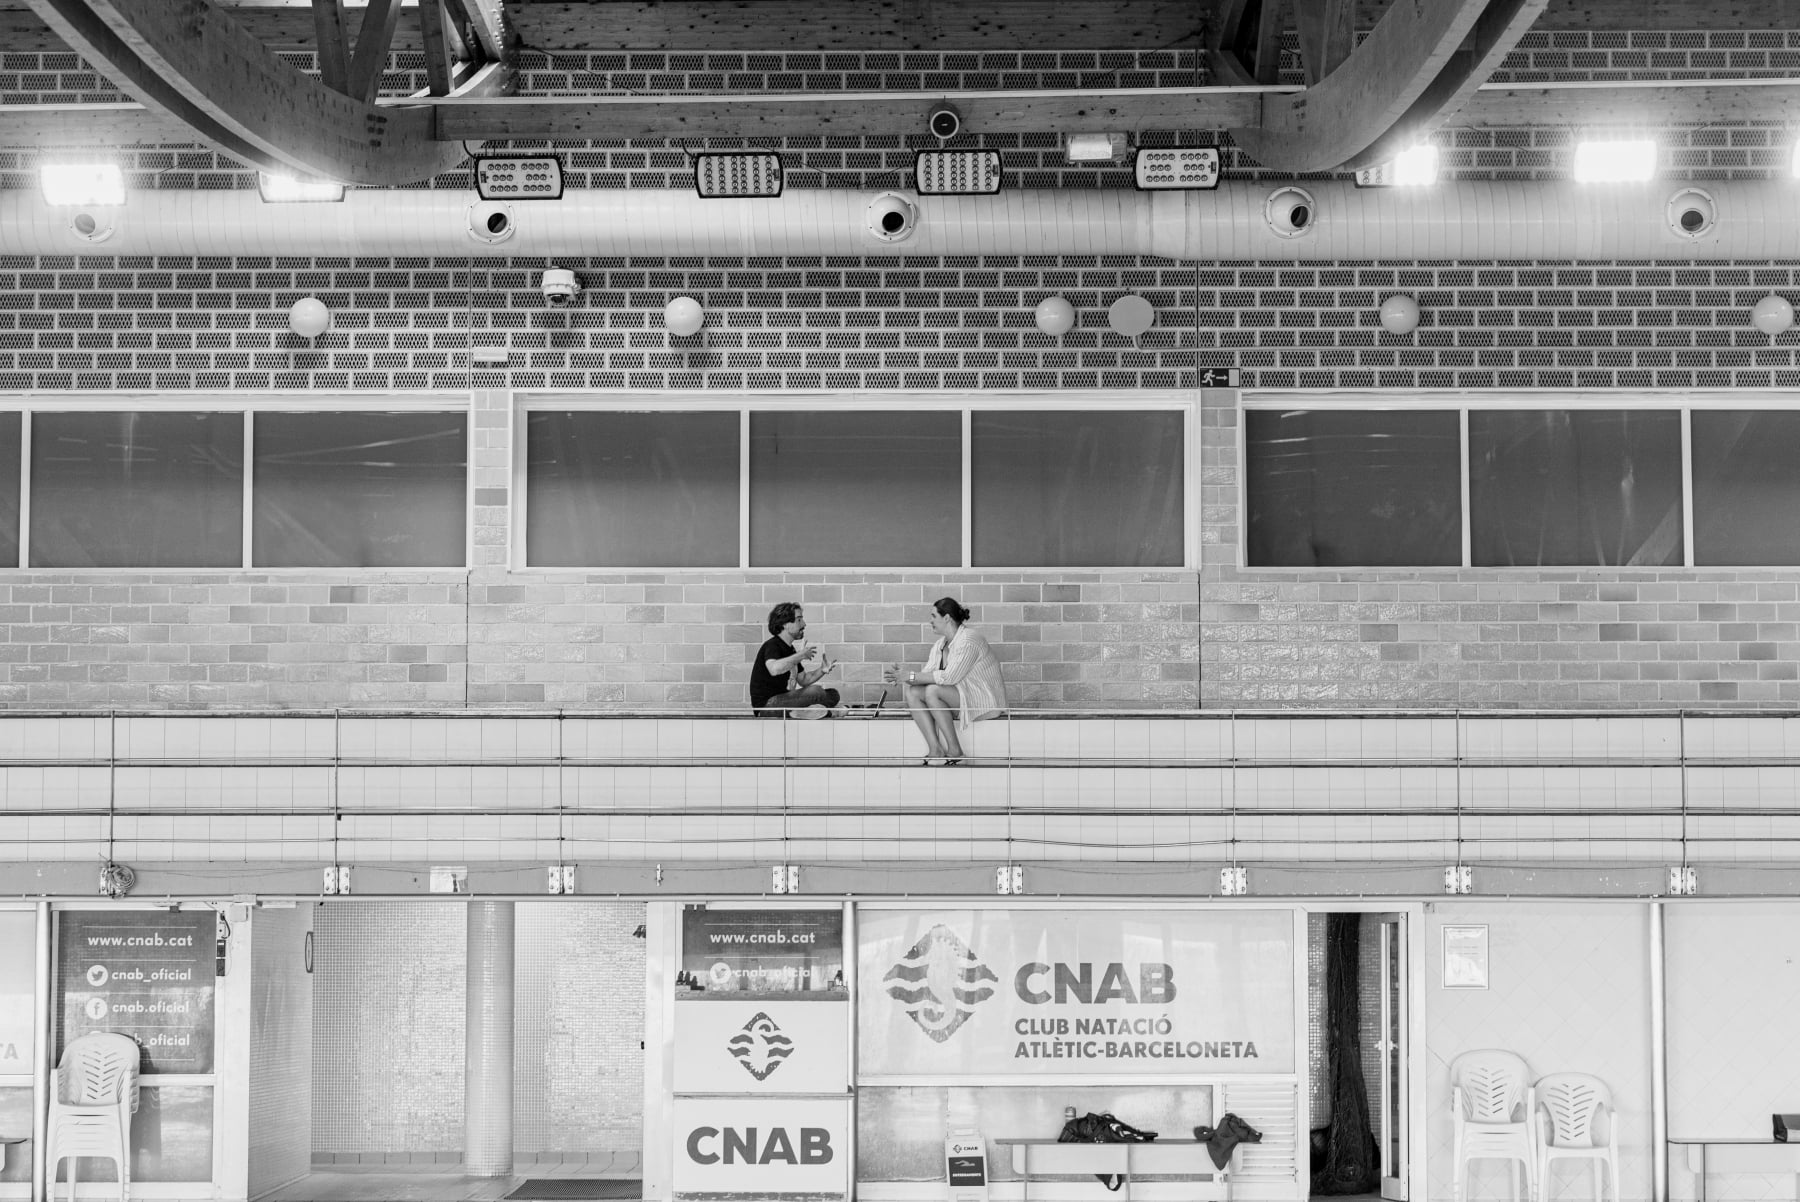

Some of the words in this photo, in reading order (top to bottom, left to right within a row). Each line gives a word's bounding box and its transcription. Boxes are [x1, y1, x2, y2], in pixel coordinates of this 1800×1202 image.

[87, 932, 193, 946] www.cnab.cat
[709, 930, 816, 944] www.cnab.cat
[111, 968, 192, 983] cnab_oficial
[1014, 962, 1177, 1005] CNAB
[112, 1000, 190, 1013] cnab.oficial
[1014, 1018, 1070, 1036] CLUB
[1075, 1013, 1173, 1036] NATACIÓ
[1014, 1036, 1259, 1059] ATLÈTIC-BARCELONETA
[686, 1126, 834, 1165] CNAB
